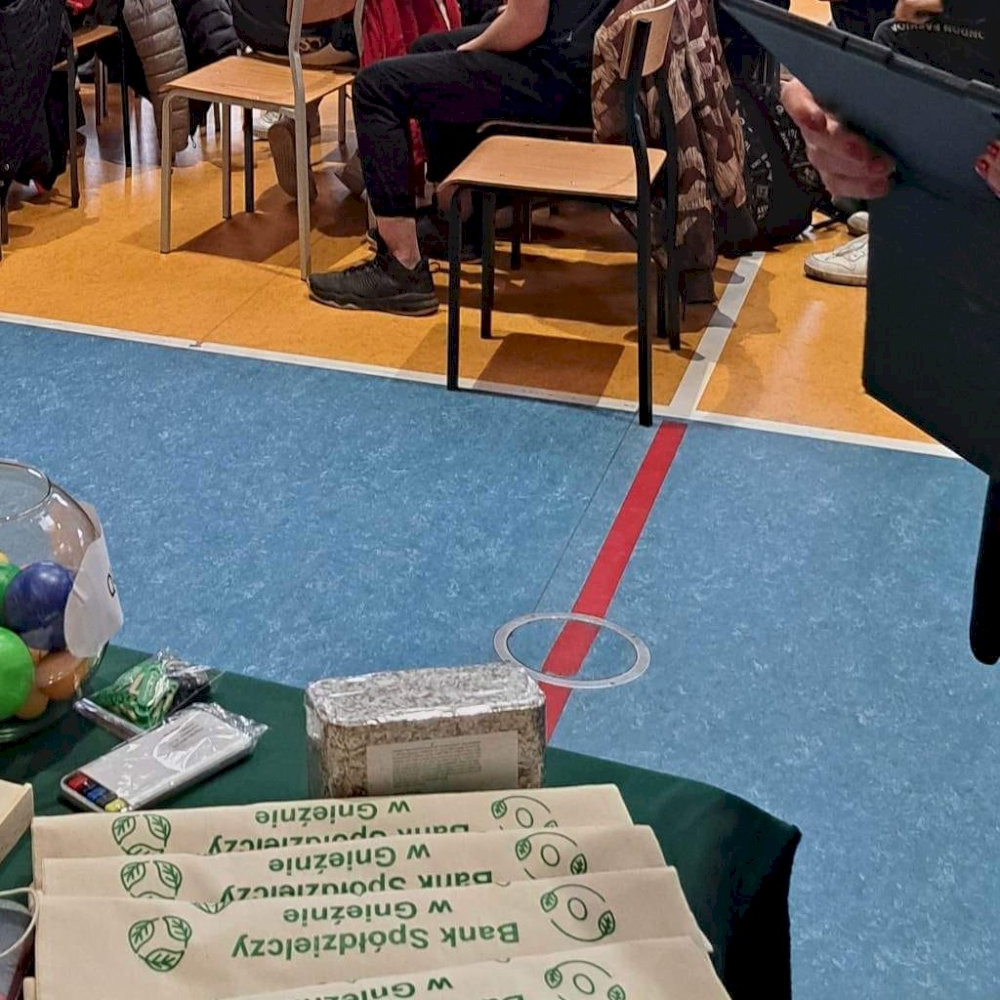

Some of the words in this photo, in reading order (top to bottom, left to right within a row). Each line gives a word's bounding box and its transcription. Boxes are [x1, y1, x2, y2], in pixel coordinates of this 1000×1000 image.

[254, 802, 377, 828] Gnieźnie
[389, 801, 411, 814] w
[267, 846, 396, 877] Gnieźnie
[407, 844, 430, 860] w
[282, 901, 418, 928] Gnieźnie
[428, 899, 453, 915] w
[231, 923, 429, 962] Spółdzielczy
[439, 922, 520, 948] Bank
[427, 976, 453, 992] w
